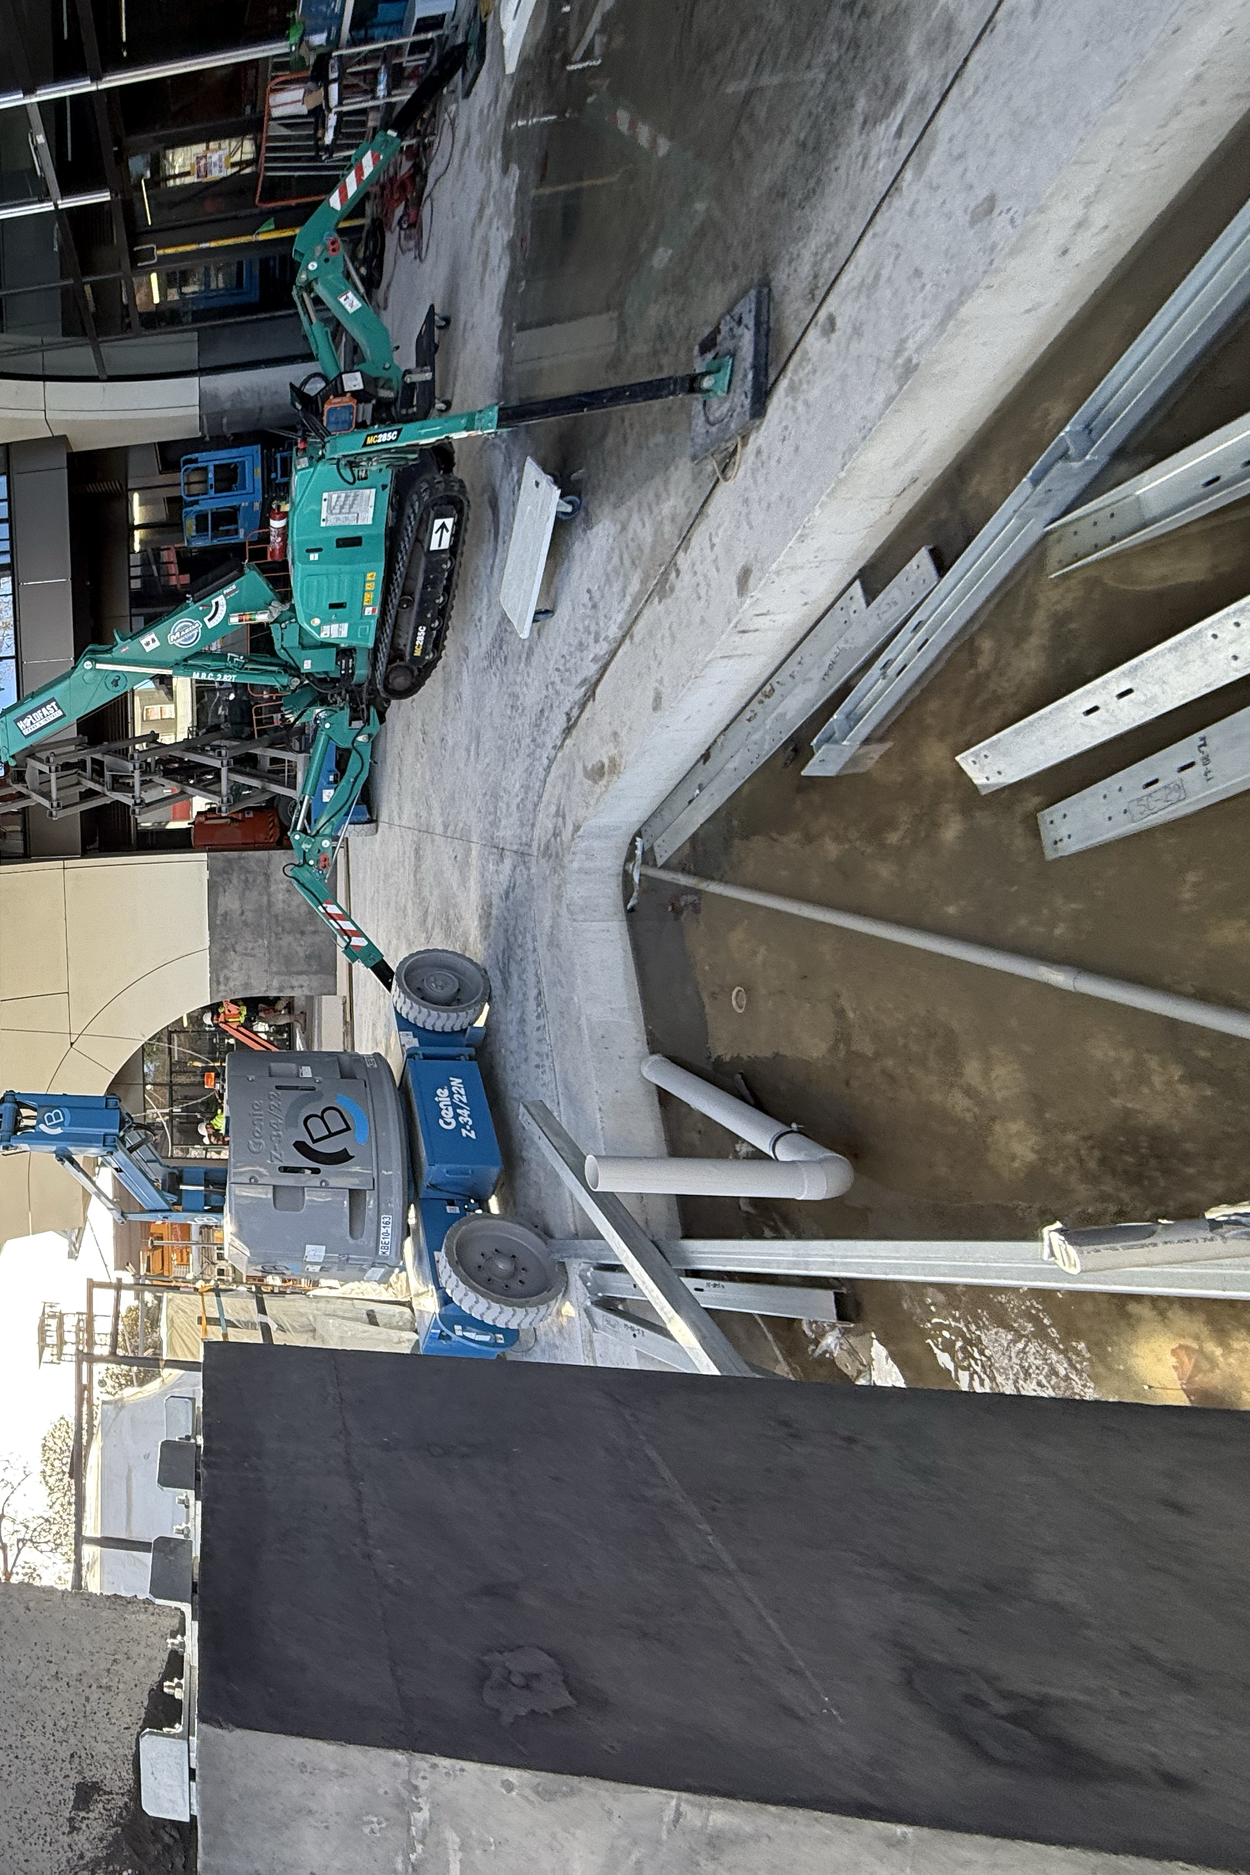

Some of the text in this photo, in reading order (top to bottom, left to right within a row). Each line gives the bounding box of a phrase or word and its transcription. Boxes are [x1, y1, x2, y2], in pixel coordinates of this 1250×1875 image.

[366, 431, 398, 445] MC285C
[413, 625, 427, 657] MC285C
[43, 1109, 64, 1126] B
[247, 1099, 265, 1155] Genie
[268, 1090, 285, 1164] Z-34/22
[303, 1106, 351, 1144] B
[434, 1087, 456, 1130] Genie
[449, 1077, 477, 1139] Z-34/22N
[380, 1215, 391, 1255] KBE10-163
